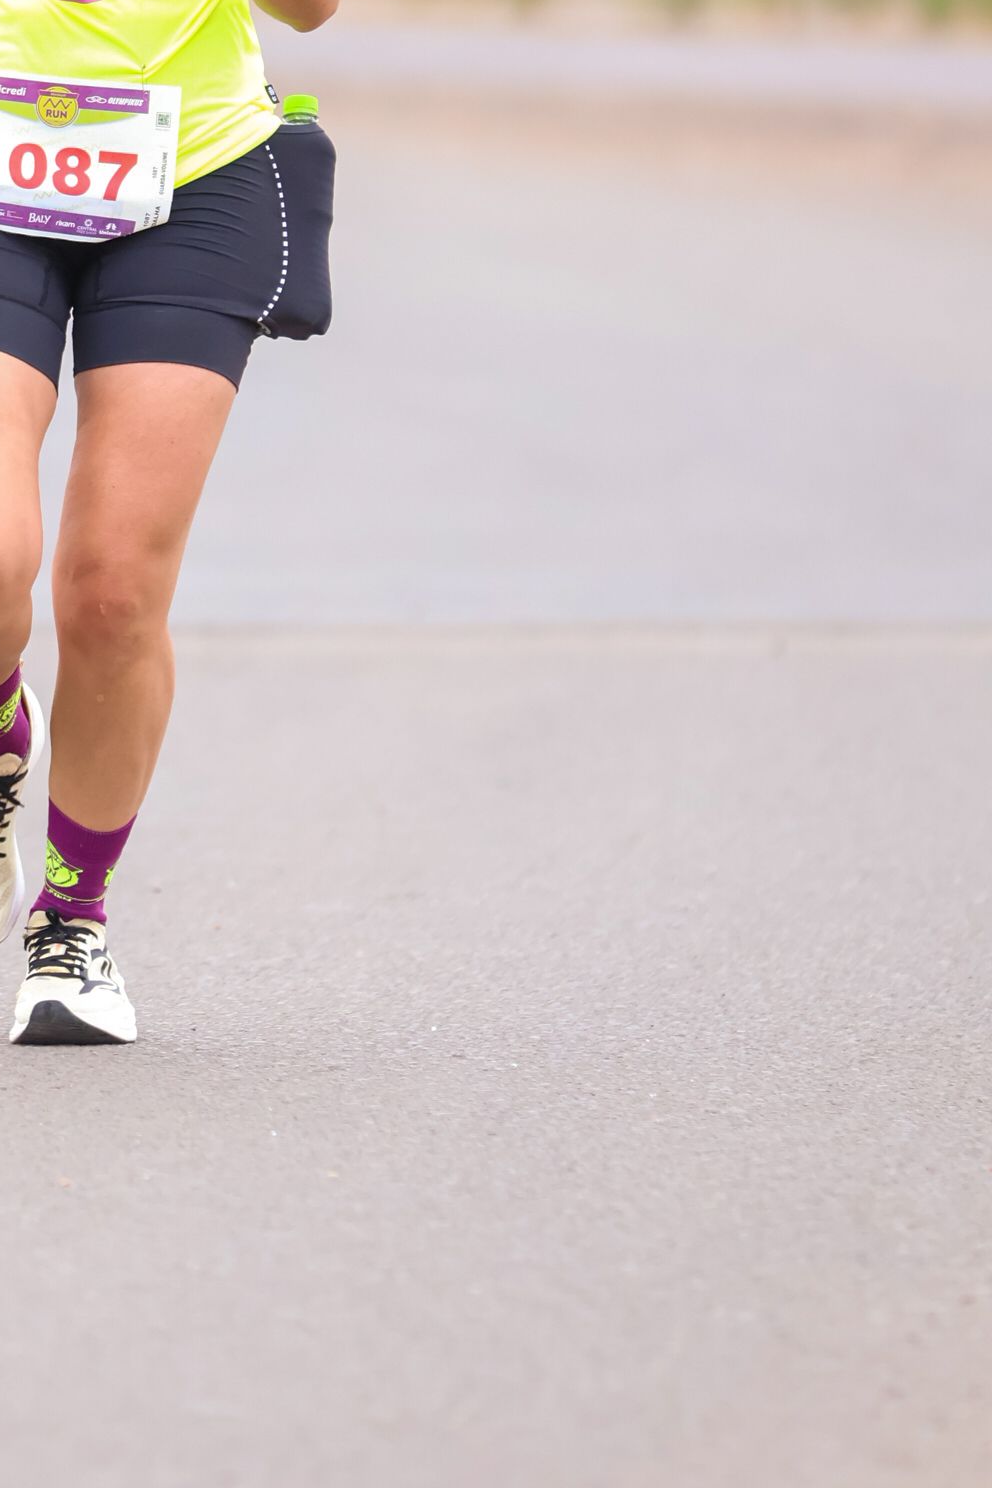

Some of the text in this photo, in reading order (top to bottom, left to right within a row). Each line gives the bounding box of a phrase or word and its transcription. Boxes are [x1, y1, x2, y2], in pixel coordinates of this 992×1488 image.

[107, 97, 144, 107] OLYMPIKUS
[45, 109, 68, 119] RUN
[28, 212, 51, 224] BALY
